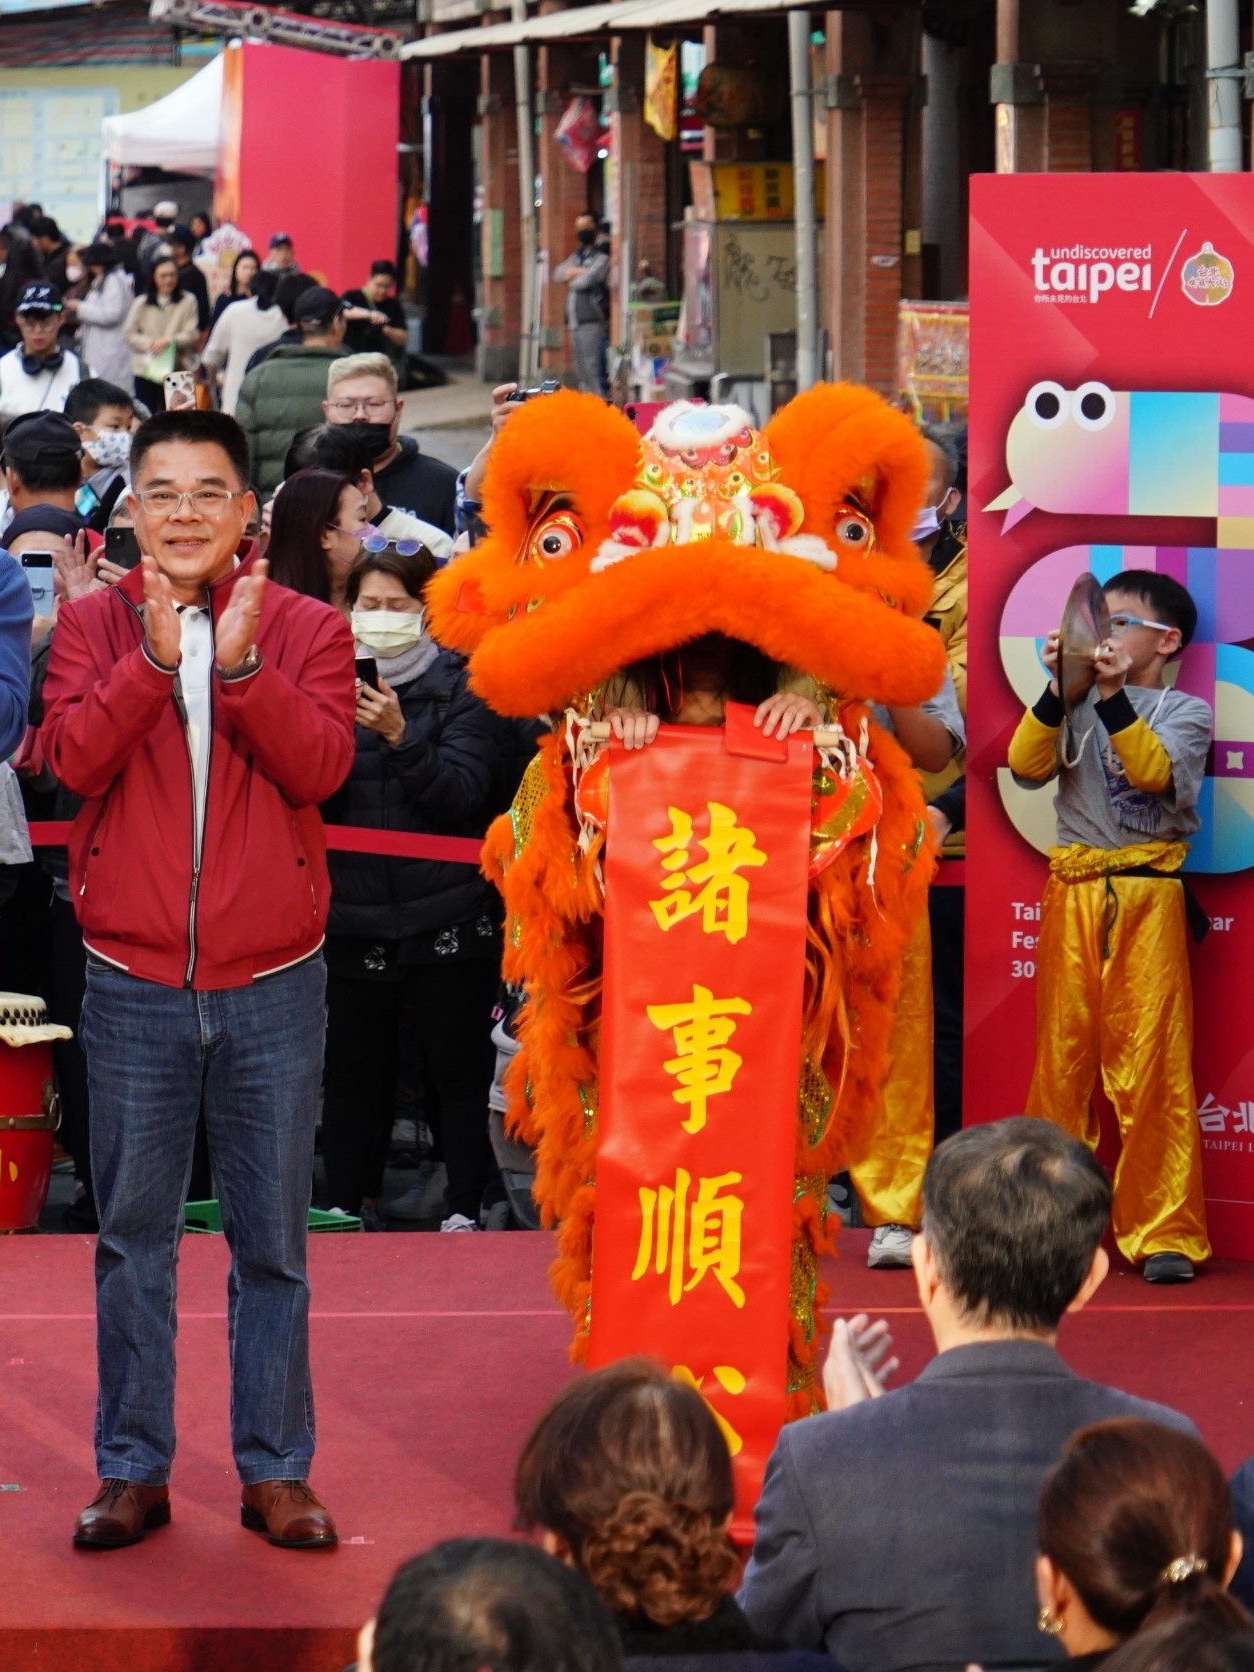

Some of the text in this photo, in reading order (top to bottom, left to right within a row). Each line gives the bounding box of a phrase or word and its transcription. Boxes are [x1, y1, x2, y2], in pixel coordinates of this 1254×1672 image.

[1050, 243, 1152, 259] undiscovered
[1031, 248, 1152, 304] taipei
[1199, 266, 1219, 277] 台北
[1011, 960, 1037, 978] 30
[1203, 1138, 1244, 1153] TAIPEI
